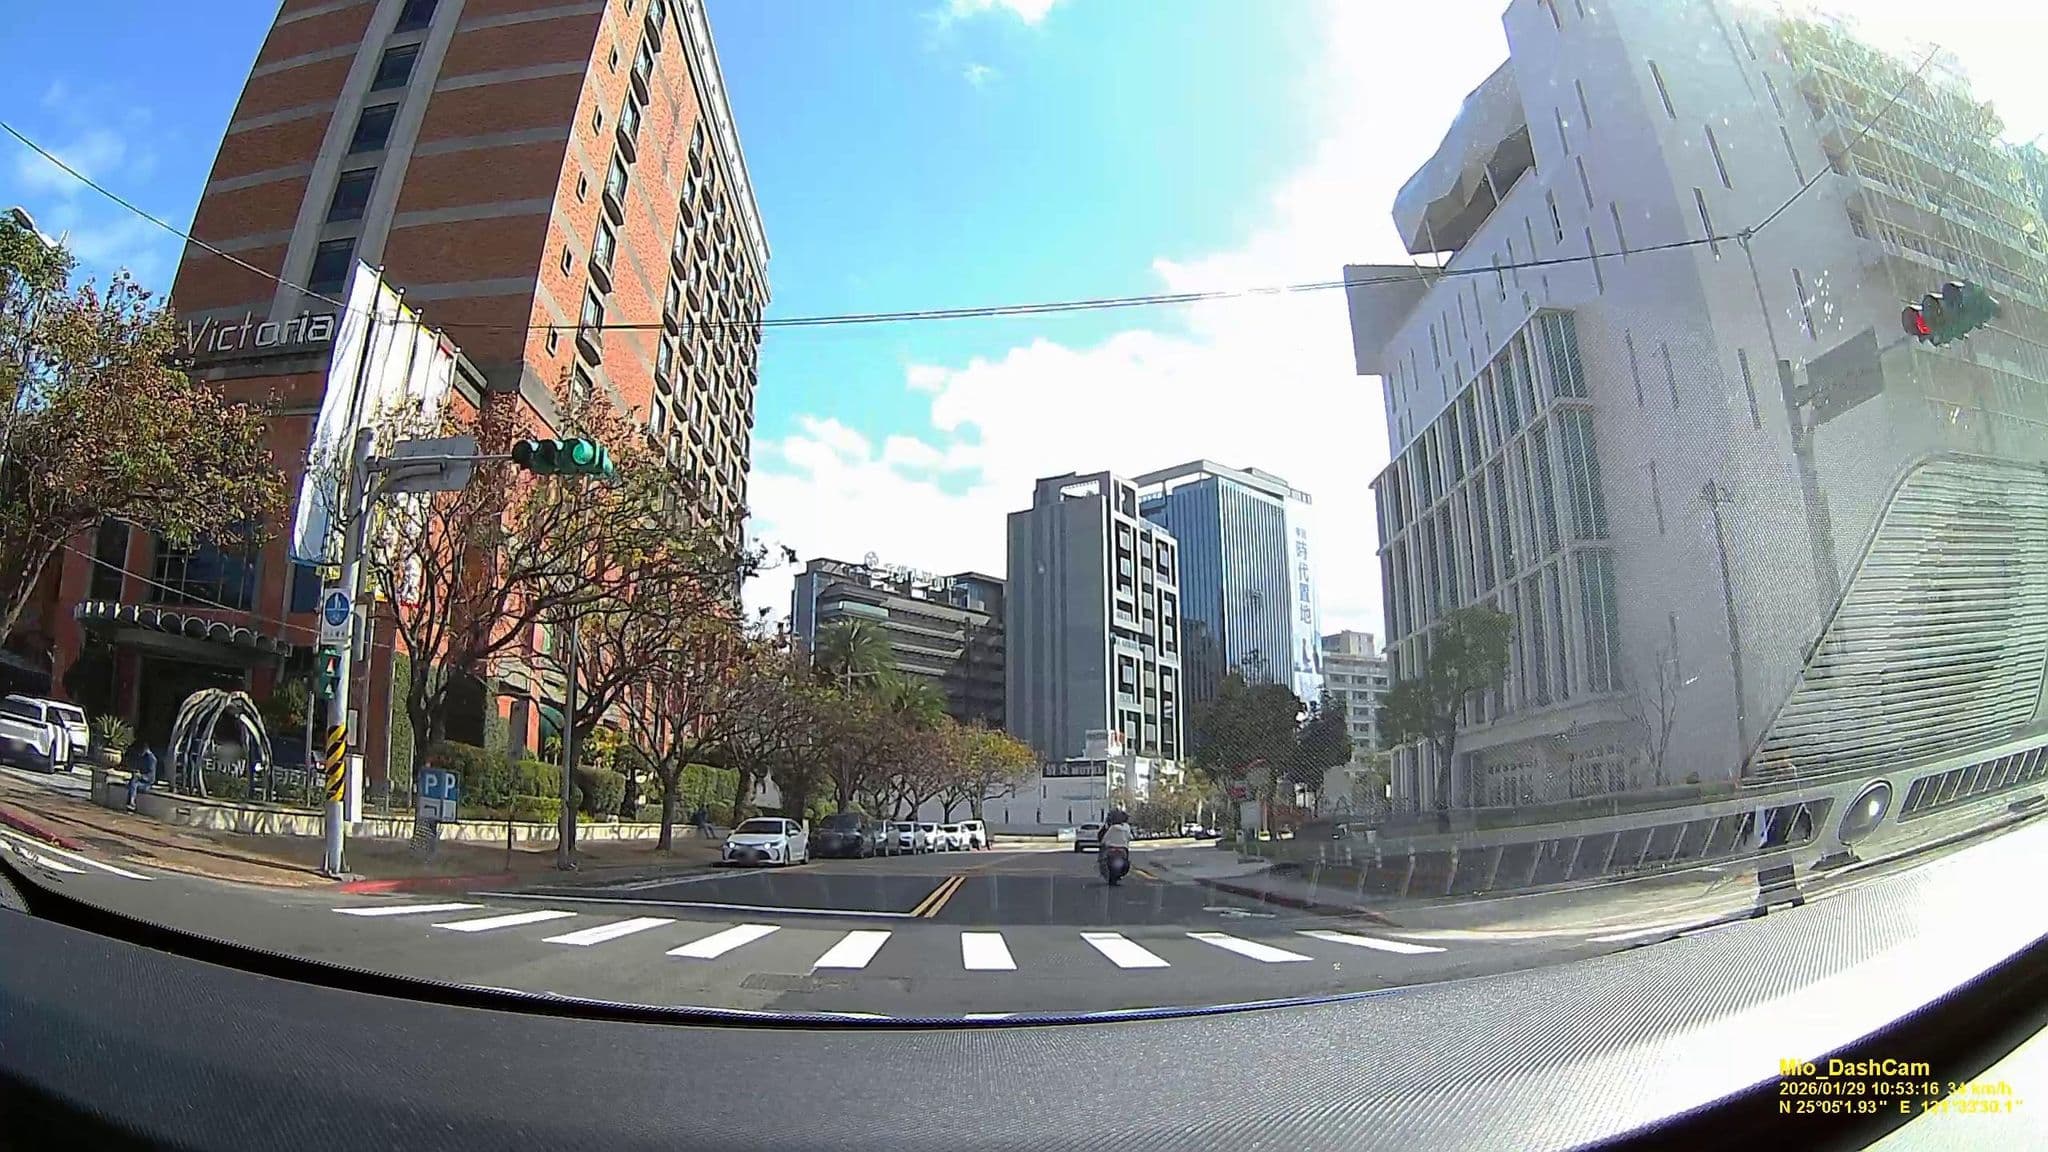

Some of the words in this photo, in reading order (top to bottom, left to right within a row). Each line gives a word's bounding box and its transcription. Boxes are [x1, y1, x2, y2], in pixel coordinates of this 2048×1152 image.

[187, 310, 334, 354] Victoria
[425, 773, 438, 795] P
[444, 773, 456, 798] P
